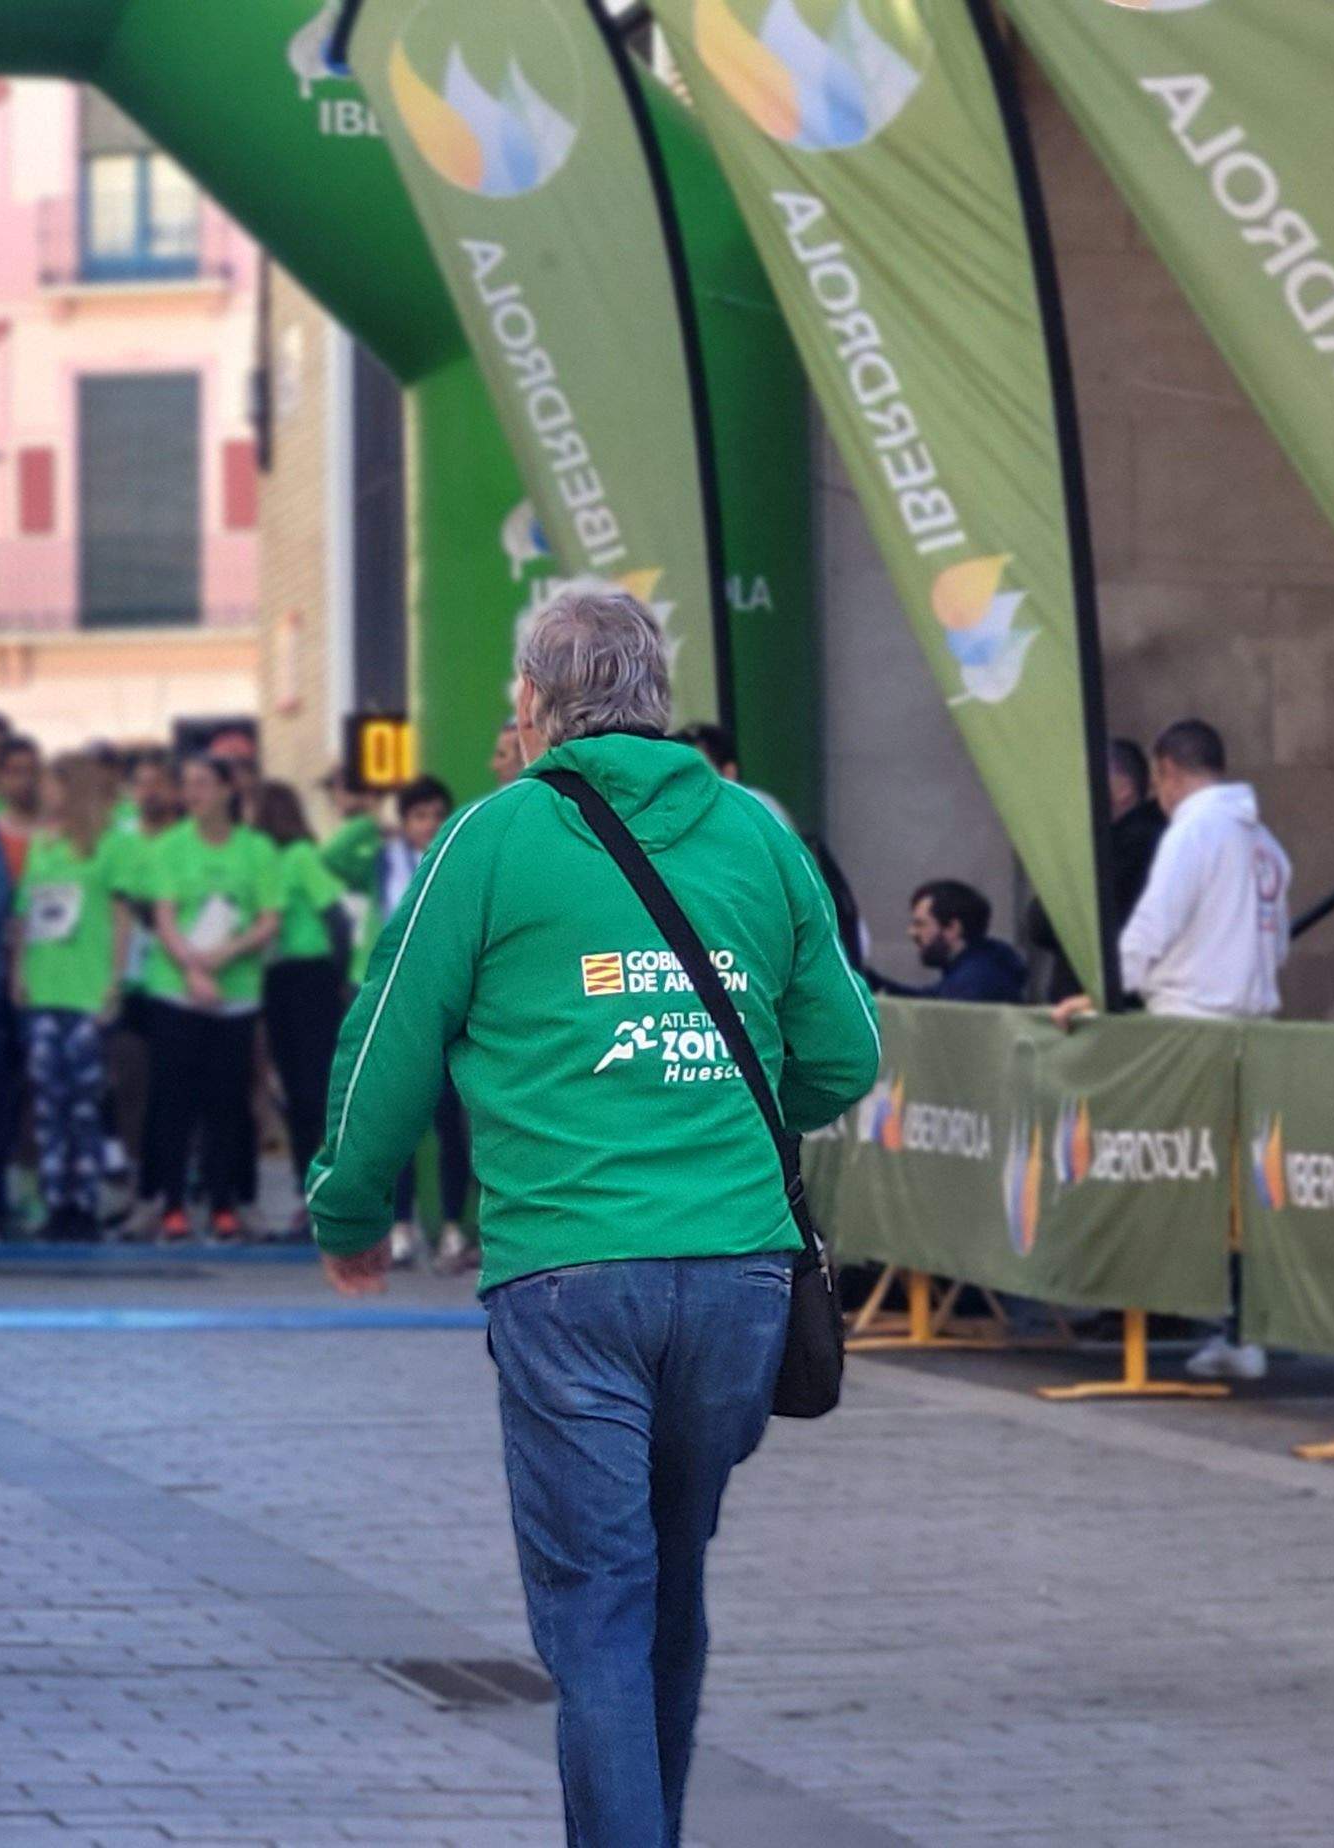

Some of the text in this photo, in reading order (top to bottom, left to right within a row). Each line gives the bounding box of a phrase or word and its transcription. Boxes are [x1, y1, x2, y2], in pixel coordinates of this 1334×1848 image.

[626, 950, 734, 971] GOBIO
[628, 971, 748, 993] DE ARON
[661, 1030, 729, 1062] ZOIT
